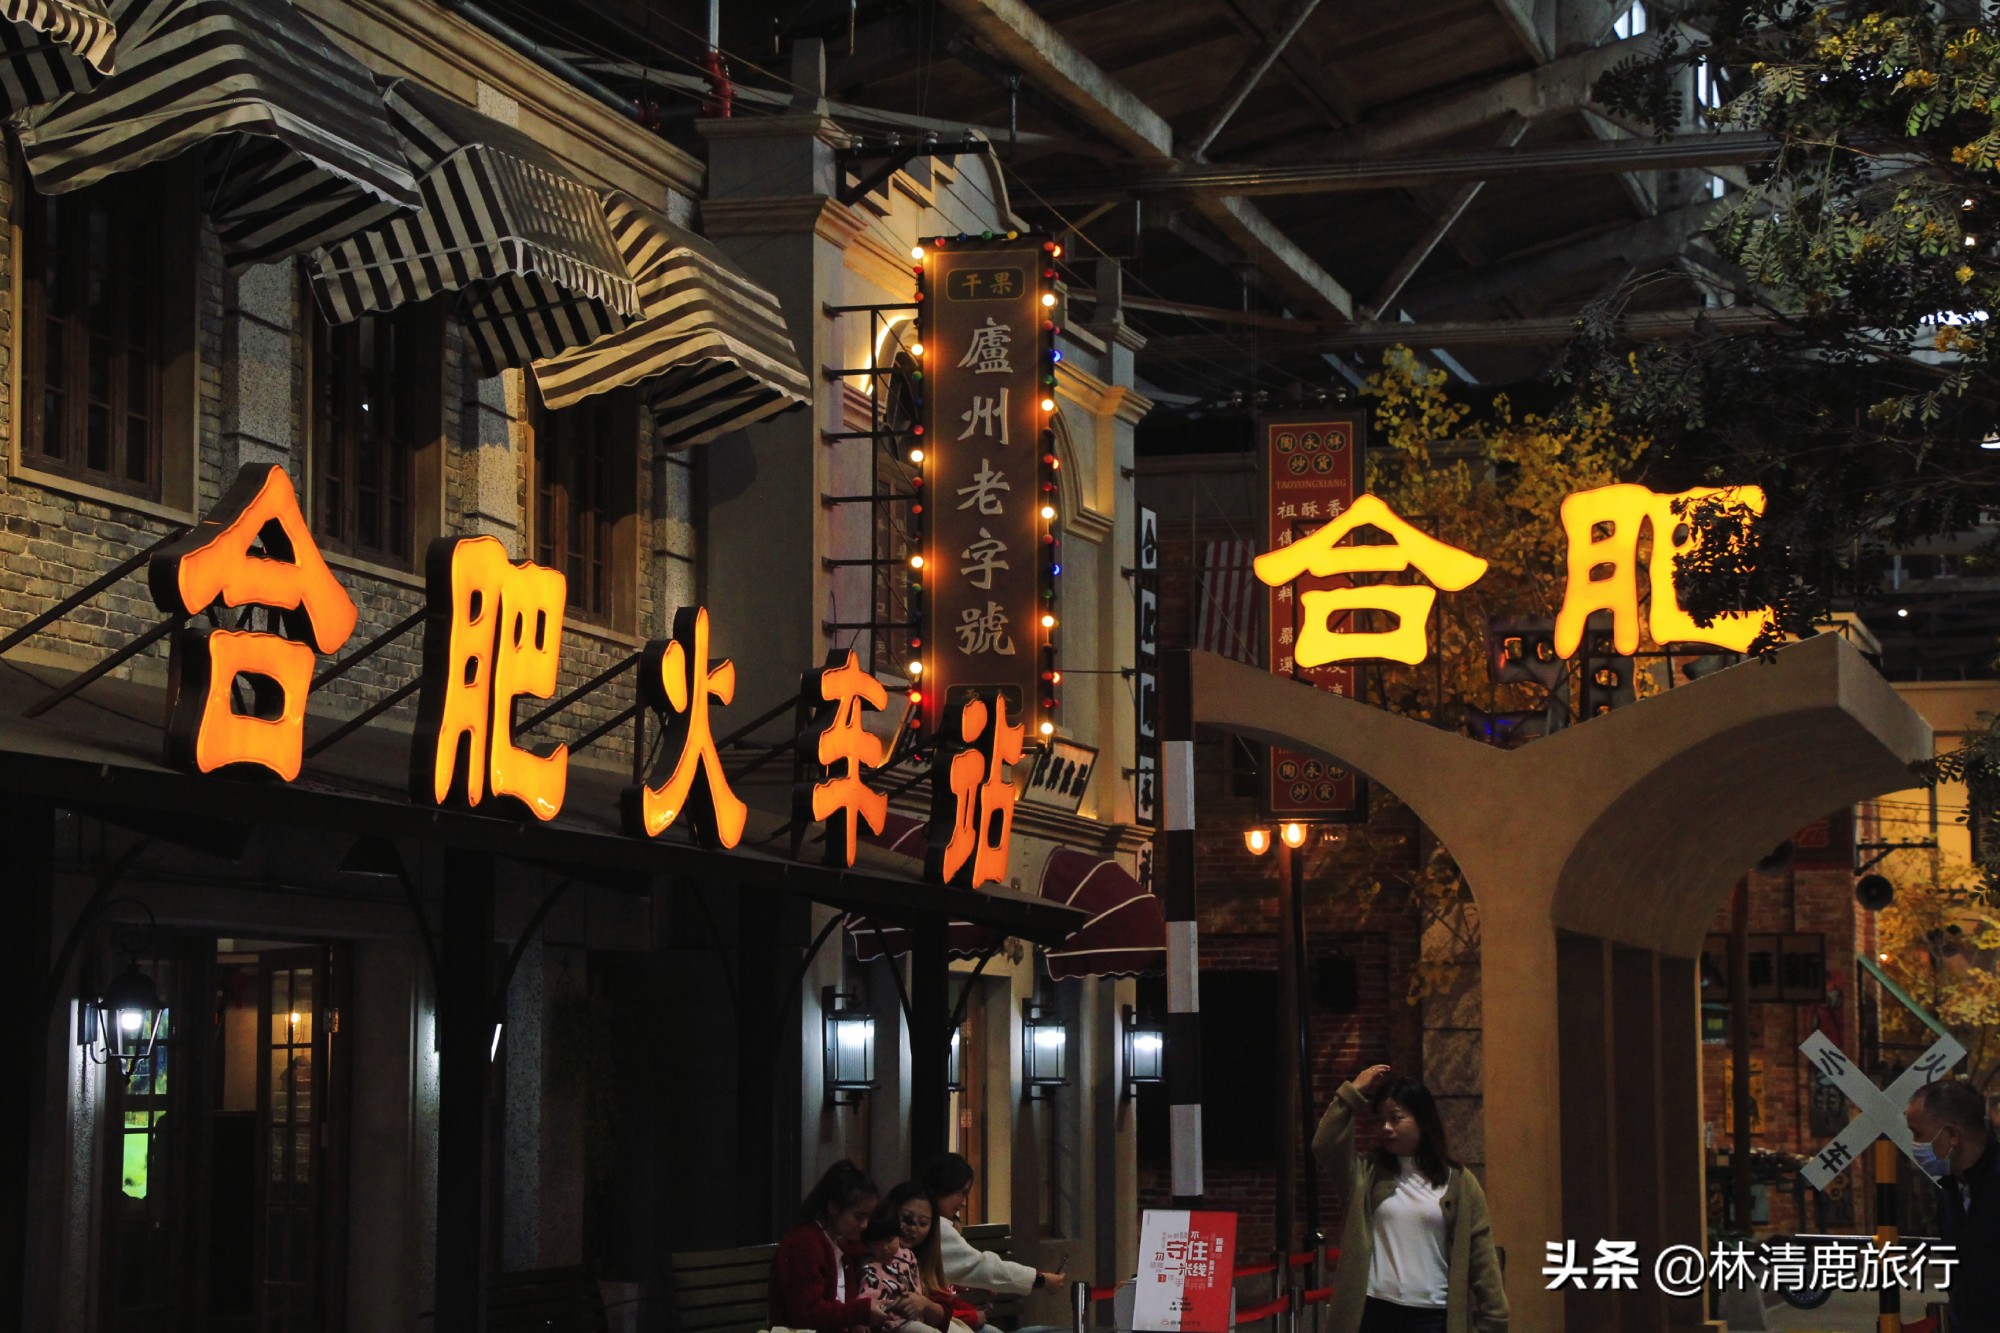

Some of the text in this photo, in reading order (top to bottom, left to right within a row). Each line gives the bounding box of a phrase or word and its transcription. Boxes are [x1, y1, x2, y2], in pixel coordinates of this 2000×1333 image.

[961, 271, 1014, 298] 干果
[955, 317, 1016, 656] 廬州老字號
[1275, 478, 1347, 490] TAOYONGXIANG
[1253, 483, 1776, 666] 合肥
[178, 463, 1025, 890] 合肥火车站
[1166, 1240, 1209, 1261] 守住
[1164, 1262, 1207, 1277] 一米线
